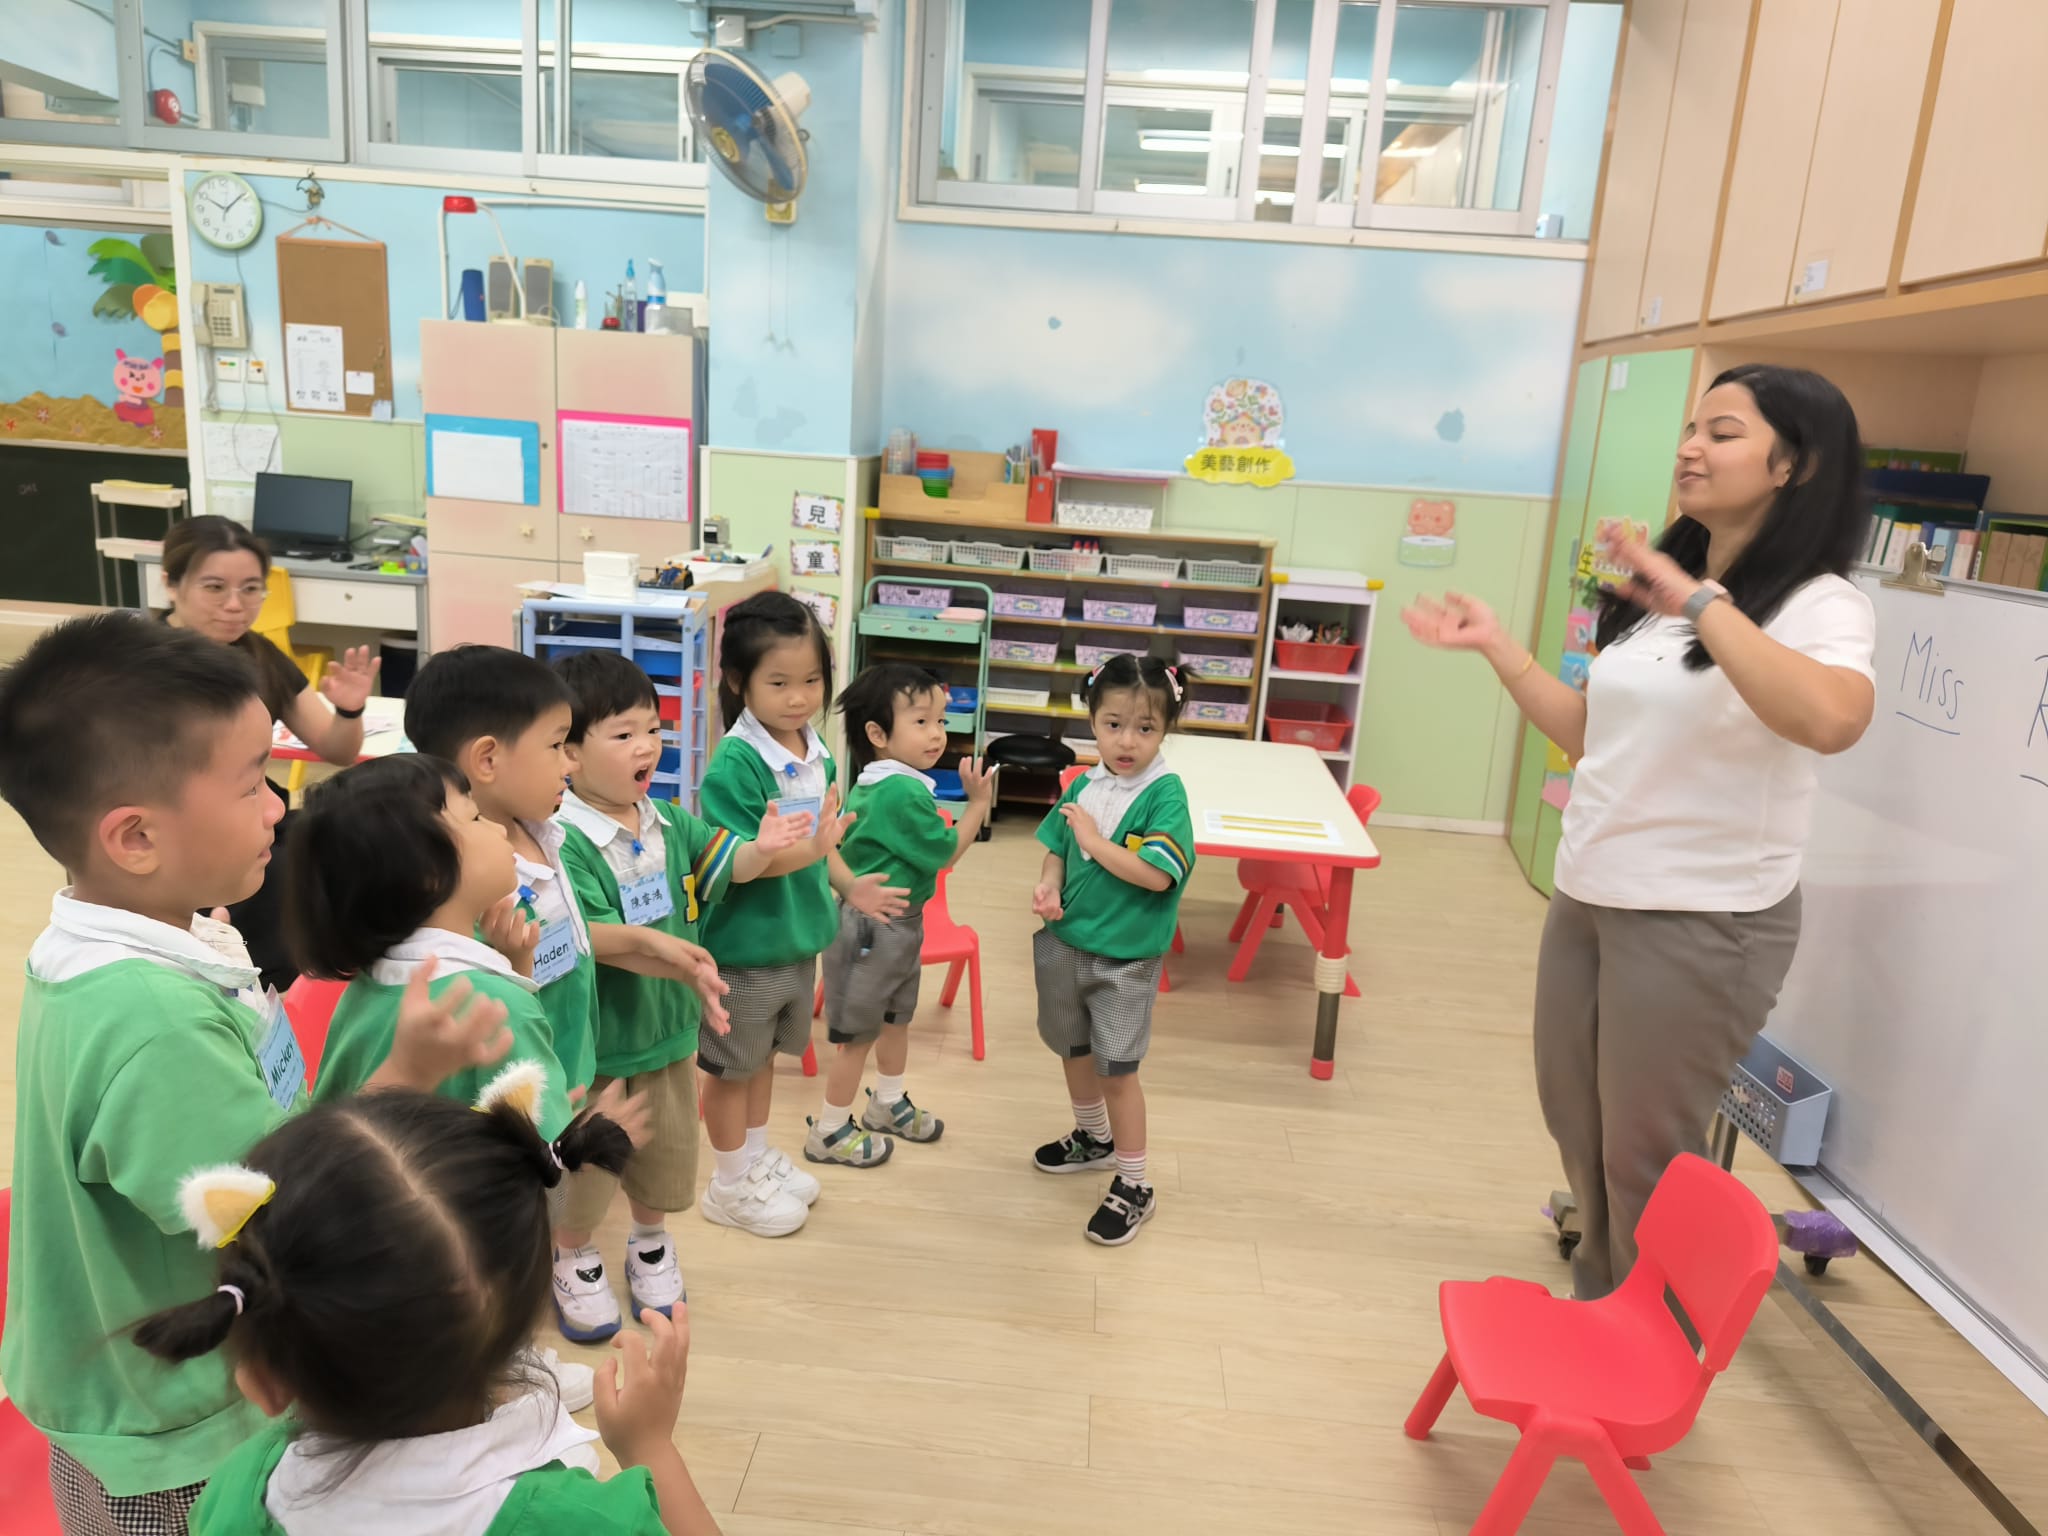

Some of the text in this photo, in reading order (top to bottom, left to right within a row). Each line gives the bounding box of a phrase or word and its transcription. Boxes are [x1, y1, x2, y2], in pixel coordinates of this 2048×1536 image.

[198, 191, 208, 200] 10
[196, 204, 205, 214] 9
[203, 218, 211, 227] 8
[213, 227, 220, 238] 7
[225, 231, 234, 242] 6
[1200, 454, 1272, 474] 美藝創作
[807, 550, 825, 570] 童
[1900, 631, 1965, 720] Miss
[534, 943, 569, 969] Haden
[271, 1038, 294, 1089] Mickey
